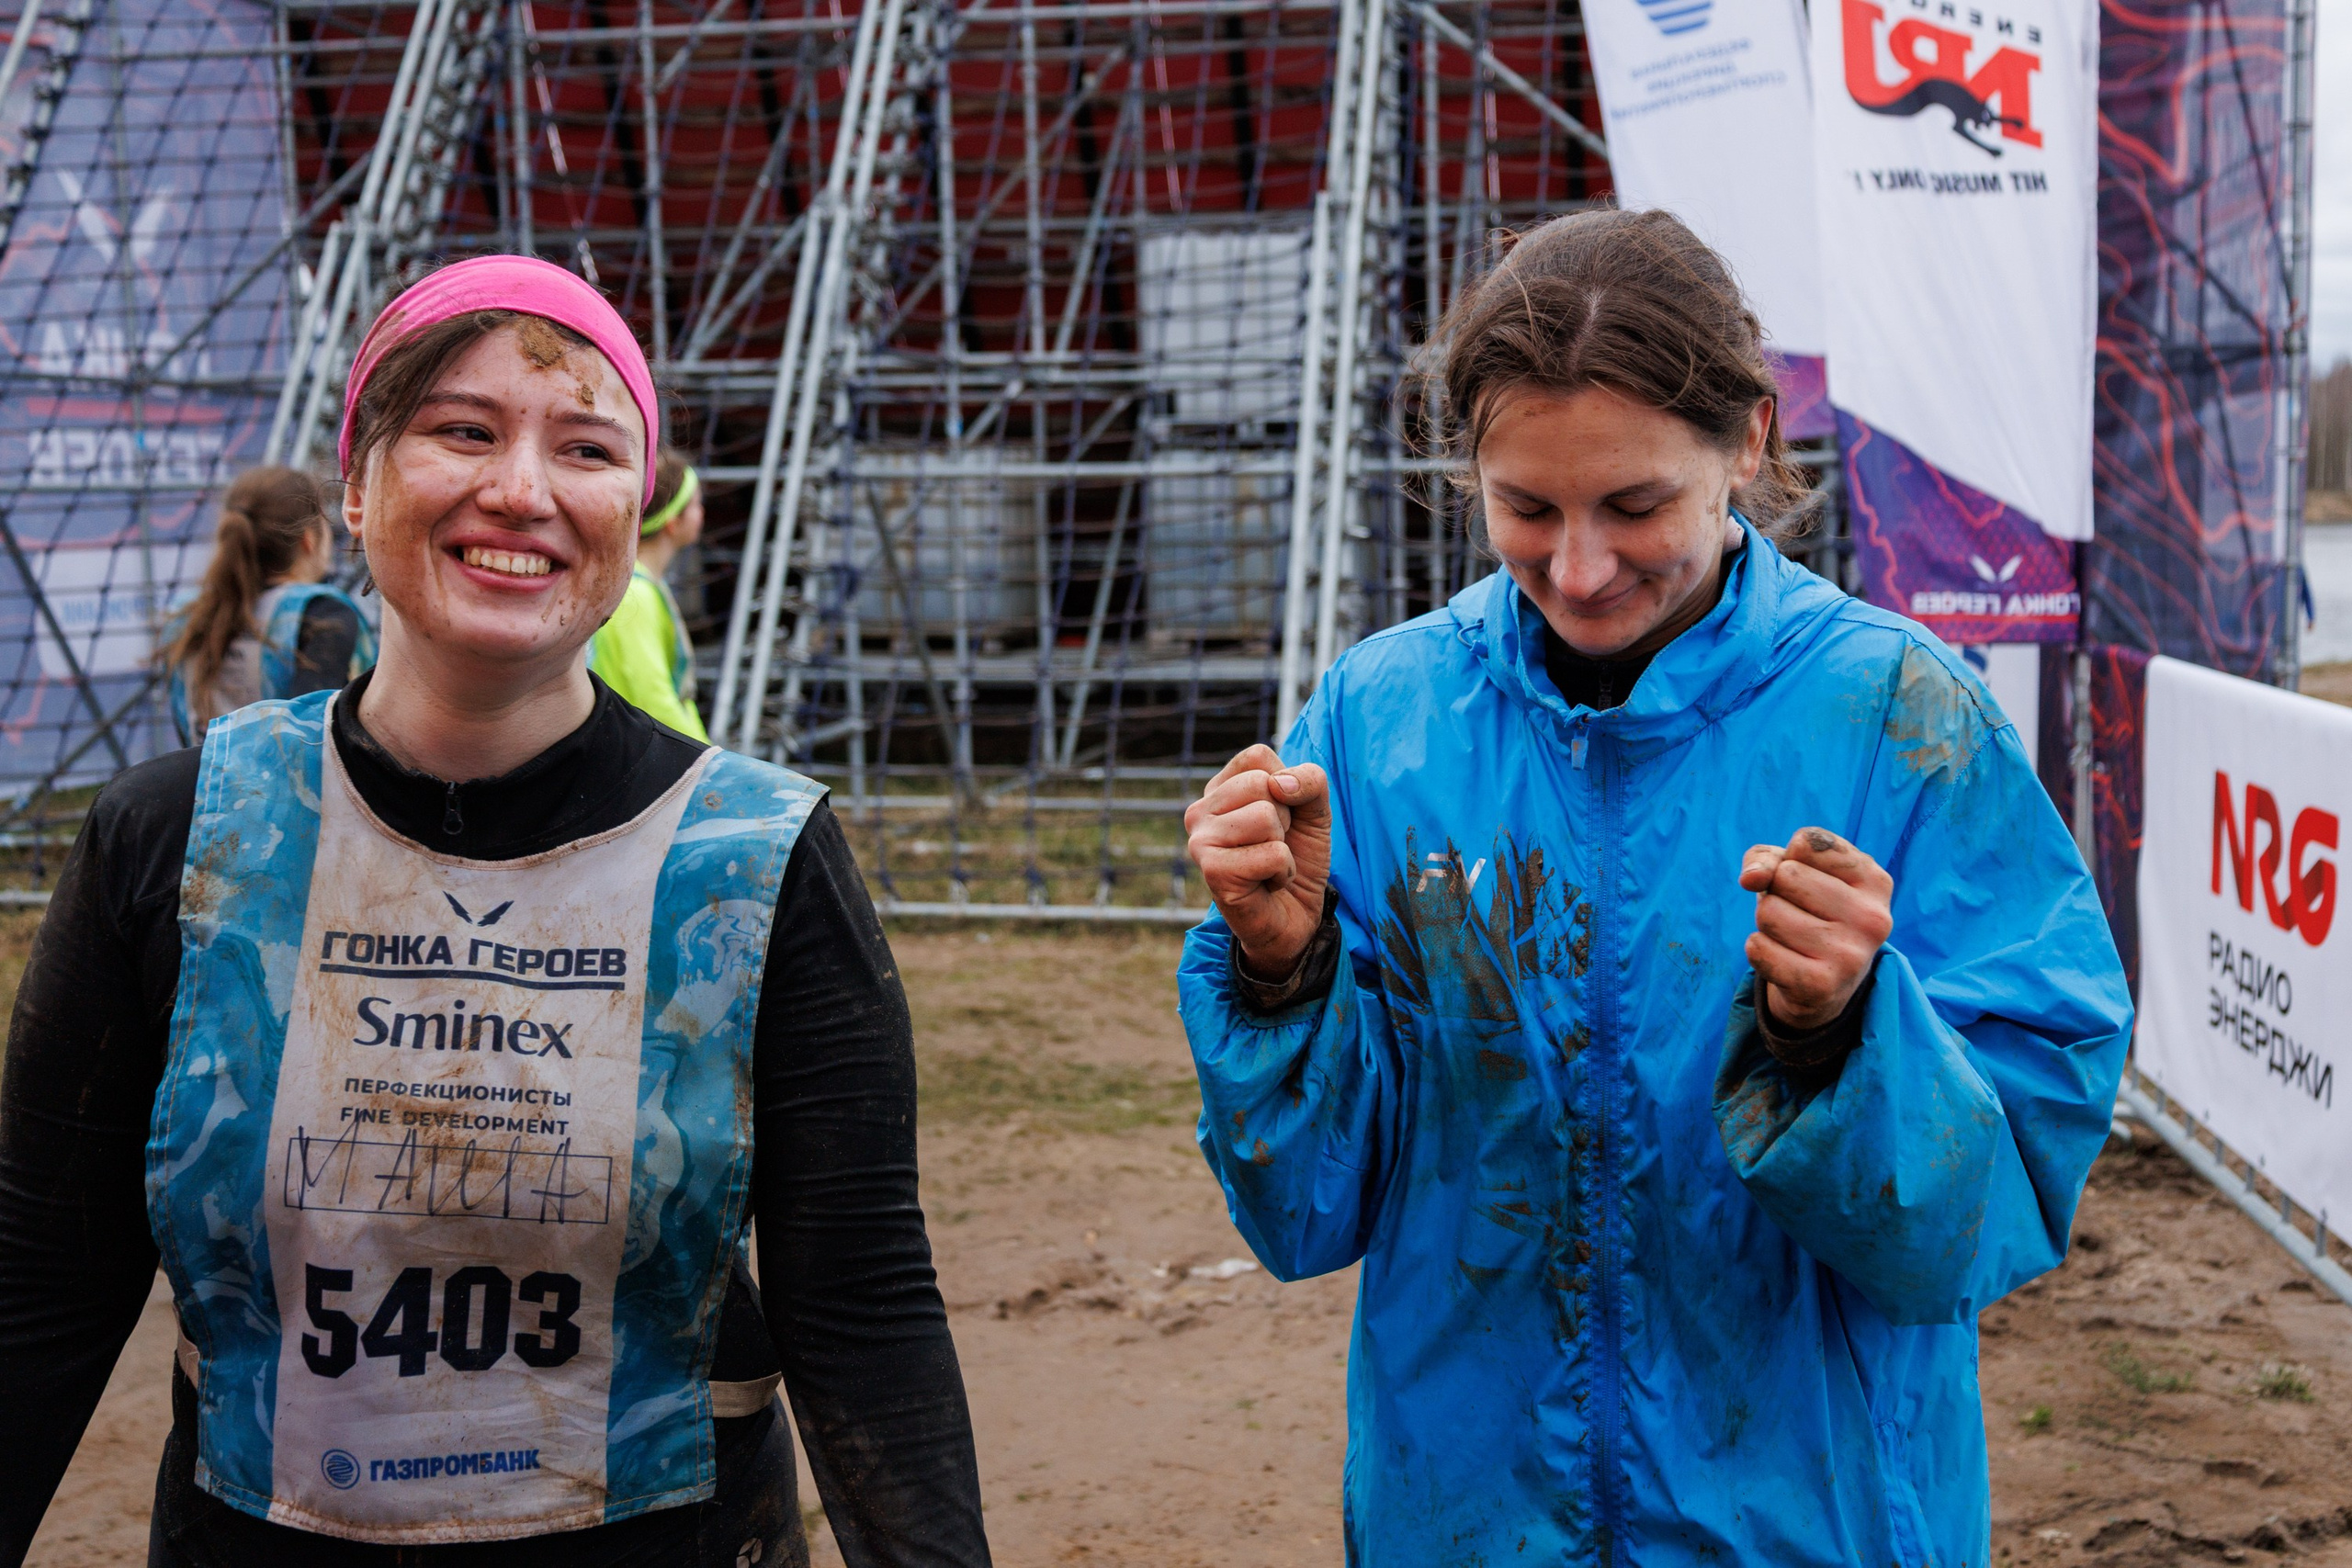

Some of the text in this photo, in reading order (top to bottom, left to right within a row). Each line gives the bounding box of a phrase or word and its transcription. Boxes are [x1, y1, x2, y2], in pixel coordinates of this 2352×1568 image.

[2211, 768, 2339, 947] NRG
[321, 931, 628, 978] ГОНКА ГЕРОЕВ
[2209, 929, 2292, 1016] РАДИО
[353, 997, 574, 1060] Sminex
[2208, 987, 2335, 1111] ЭНЕРДЖИ
[340, 1107, 570, 1135] FINE DEVELOPMENT
[344, 1077, 571, 1107] ПЕРФЕКЦИОНИСТЫ
[300, 1262, 582, 1379] 5403
[369, 1449, 541, 1483] ГАЗПРОМБАНК
